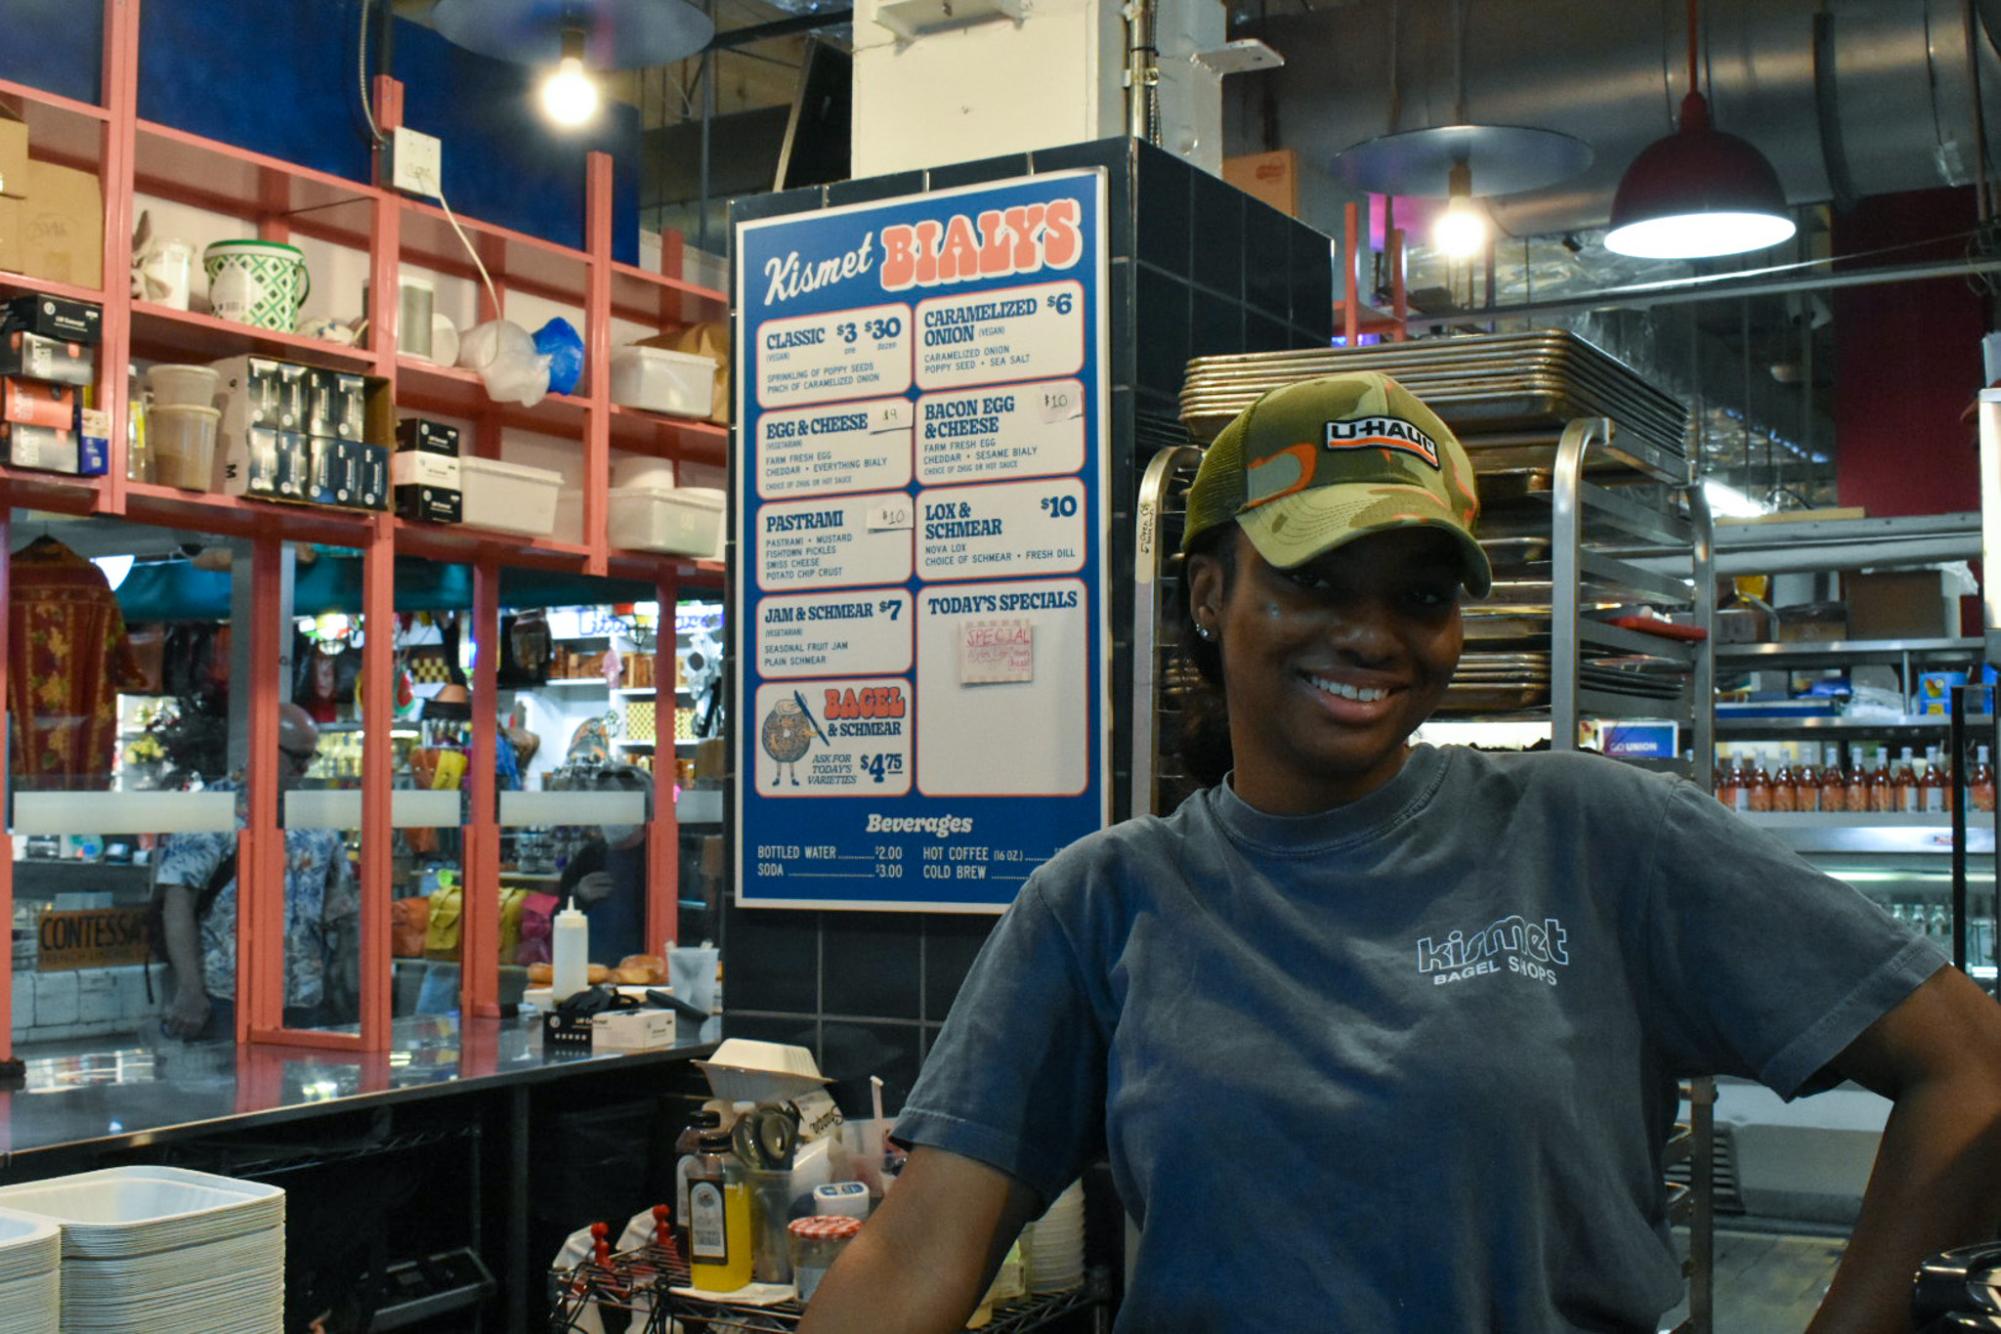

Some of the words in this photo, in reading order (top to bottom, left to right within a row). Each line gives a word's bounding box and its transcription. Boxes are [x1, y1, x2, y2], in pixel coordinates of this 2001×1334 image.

[764, 232, 873, 306] Kismet
[880, 198, 1082, 292] BIALYS
[924, 298, 1037, 327] CARAMELIZED
[1047, 293, 1072, 314] $6
[767, 328, 825, 349] CLASSIC
[837, 323, 857, 343] $3
[865, 317, 901, 340] $30
[924, 325, 974, 346] ONION
[979, 326, 1005, 337] (VEGAN)
[767, 353, 790, 362] (VEGAN)
[924, 349, 980, 363] CARAMELIZED
[984, 345, 1009, 355] ONION
[768, 370, 808, 382] SPRINKLING
[823, 366, 847, 376] POPPY
[851, 362, 873, 373] SEEDS
[925, 363, 950, 374] POPPY
[956, 361, 975, 371] SEED
[990, 357, 1006, 367] SEA
[1010, 355, 1030, 363] SALT
[768, 384, 788, 394] PINCH
[791, 383, 799, 391] OF
[803, 376, 853, 390] CARAMELIZED
[857, 374, 880, 384] ONION
[925, 400, 977, 420] BACON
[983, 396, 1014, 414] EGG
[1045, 394, 1067, 408] $10
[767, 422, 795, 439] EGG
[798, 420, 808, 435] &
[811, 413, 868, 434] CHEESE
[925, 423, 936, 439] &
[939, 417, 999, 438] CHEESE
[924, 442, 946, 452] FARM
[951, 440, 976, 450] FRESH
[981, 438, 995, 447] EGG
[766, 456, 786, 465] FARM
[790, 453, 813, 462] FRESH
[817, 452, 831, 460] EGG
[924, 453, 961, 465] CHEDDAR
[976, 449, 1008, 460] SESAME
[1013, 447, 1038, 457] BIALY
[766, 467, 800, 477] CHEDDAR
[814, 460, 860, 473] EVERYTHING
[865, 458, 887, 467] BIALY
[924, 466, 944, 475] CHOICE
[948, 465, 954, 473] OF
[999, 461, 1018, 469] SAUCE
[766, 482, 784, 490] CHOICE
[926, 503, 956, 520] LOX
[959, 502, 971, 518] &
[1041, 495, 1077, 518] $10
[767, 510, 843, 532] PASTRAMI
[883, 509, 904, 524] $10
[926, 519, 1002, 540] SCHMEAR
[766, 537, 803, 547] PASTRAMI
[817, 533, 852, 543] MUSTARD
[766, 549, 802, 558] FISHTOWN
[806, 546, 836, 555] PICKLES
[926, 545, 947, 553] NOVA
[926, 556, 953, 566] CHOICE
[958, 555, 967, 564] OF
[973, 553, 1012, 563] SCHMEAR
[1026, 551, 1052, 559] FRESH
[1057, 549, 1075, 558] DILL
[767, 560, 787, 569] SWISS
[791, 558, 819, 567] CHEESE
[767, 570, 794, 580] POTATO
[798, 569, 814, 578] CHIP
[819, 567, 842, 576] CRUST
[928, 595, 996, 614] TODAY'S
[1000, 590, 1077, 611] SPECIALS
[765, 608, 793, 623] JAM
[796, 607, 805, 620] &
[809, 603, 873, 620] SCHMEAR
[879, 600, 902, 620] $7
[968, 628, 1030, 647] SPECIAL
[765, 645, 803, 654] SEASONAL
[808, 643, 828, 651] FRUIT
[831, 642, 848, 650] JAM
[765, 658, 786, 666] PLAIN
[790, 656, 826, 665] SCHMEAR
[824, 687, 906, 720] BAGEL
[828, 724, 838, 736] &
[840, 722, 901, 736] SCHMEAR
[1626, 742, 1657, 751] UNION
[812, 755, 831, 763] ASK
[832, 754, 851, 762] FOR
[813, 765, 852, 773] TODAY'S
[808, 775, 857, 784] VARIETIES
[866, 814, 973, 838] Beverages
[758, 846, 799, 859] BOTTLED
[804, 846, 836, 859] WATER
[876, 847, 902, 860] $2.00
[923, 847, 943, 860] HOT
[949, 847, 989, 861] COFFEE
[758, 864, 783, 876] SODA
[923, 865, 950, 879] COLD
[957, 866, 986, 879] BREW
[1417, 915, 1568, 973] kismet
[1434, 960, 1500, 985] BAGEL
[1509, 956, 1557, 985] SHOPS
